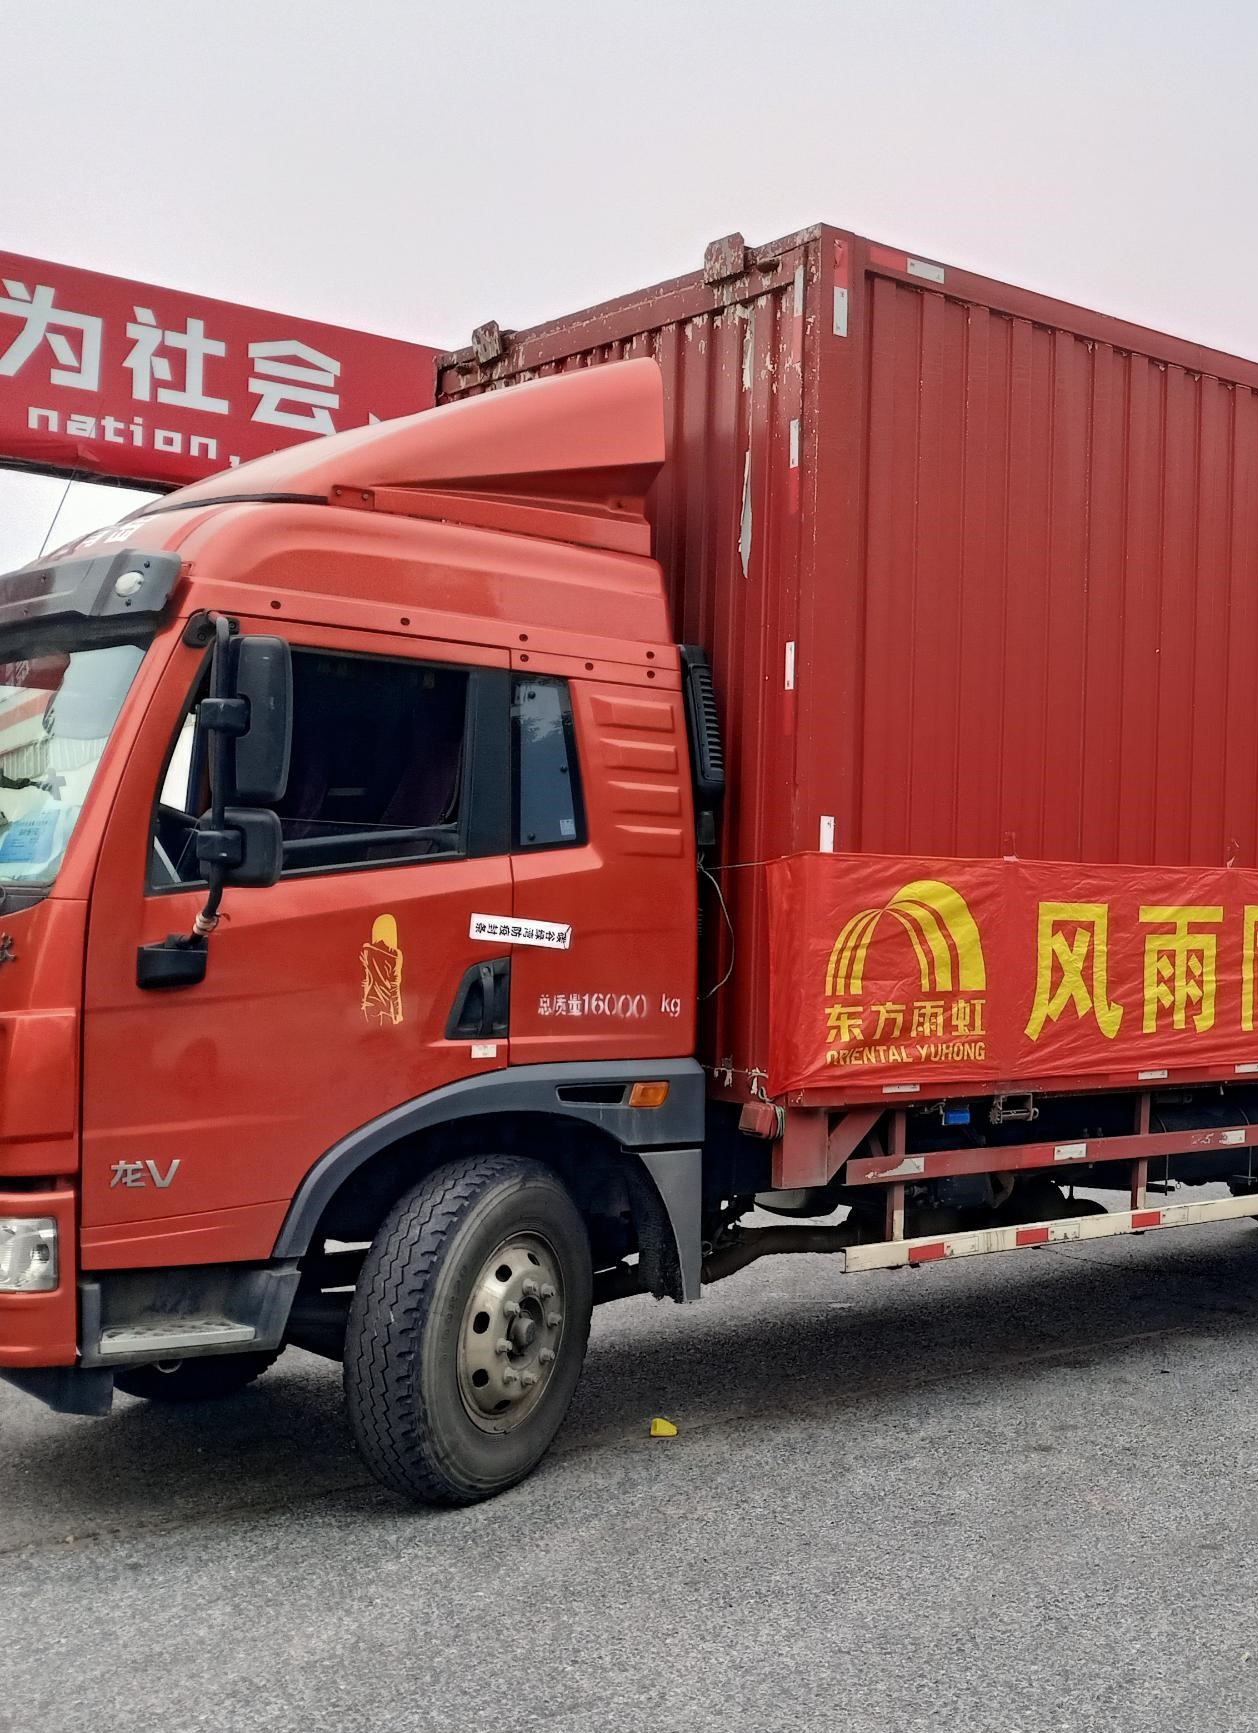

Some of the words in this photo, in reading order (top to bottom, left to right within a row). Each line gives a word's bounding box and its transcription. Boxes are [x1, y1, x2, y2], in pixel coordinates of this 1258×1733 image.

[0, 279, 341, 435] 为社会
[538, 993, 647, 1017] 总质量16000
[660, 993, 681, 1017] kg
[825, 1000, 987, 1043] 东方雨虹
[826, 1044, 913, 1065] ORIENTAL
[916, 1041, 986, 1062] YUHONG
[110, 1159, 181, 1188] 龙V
